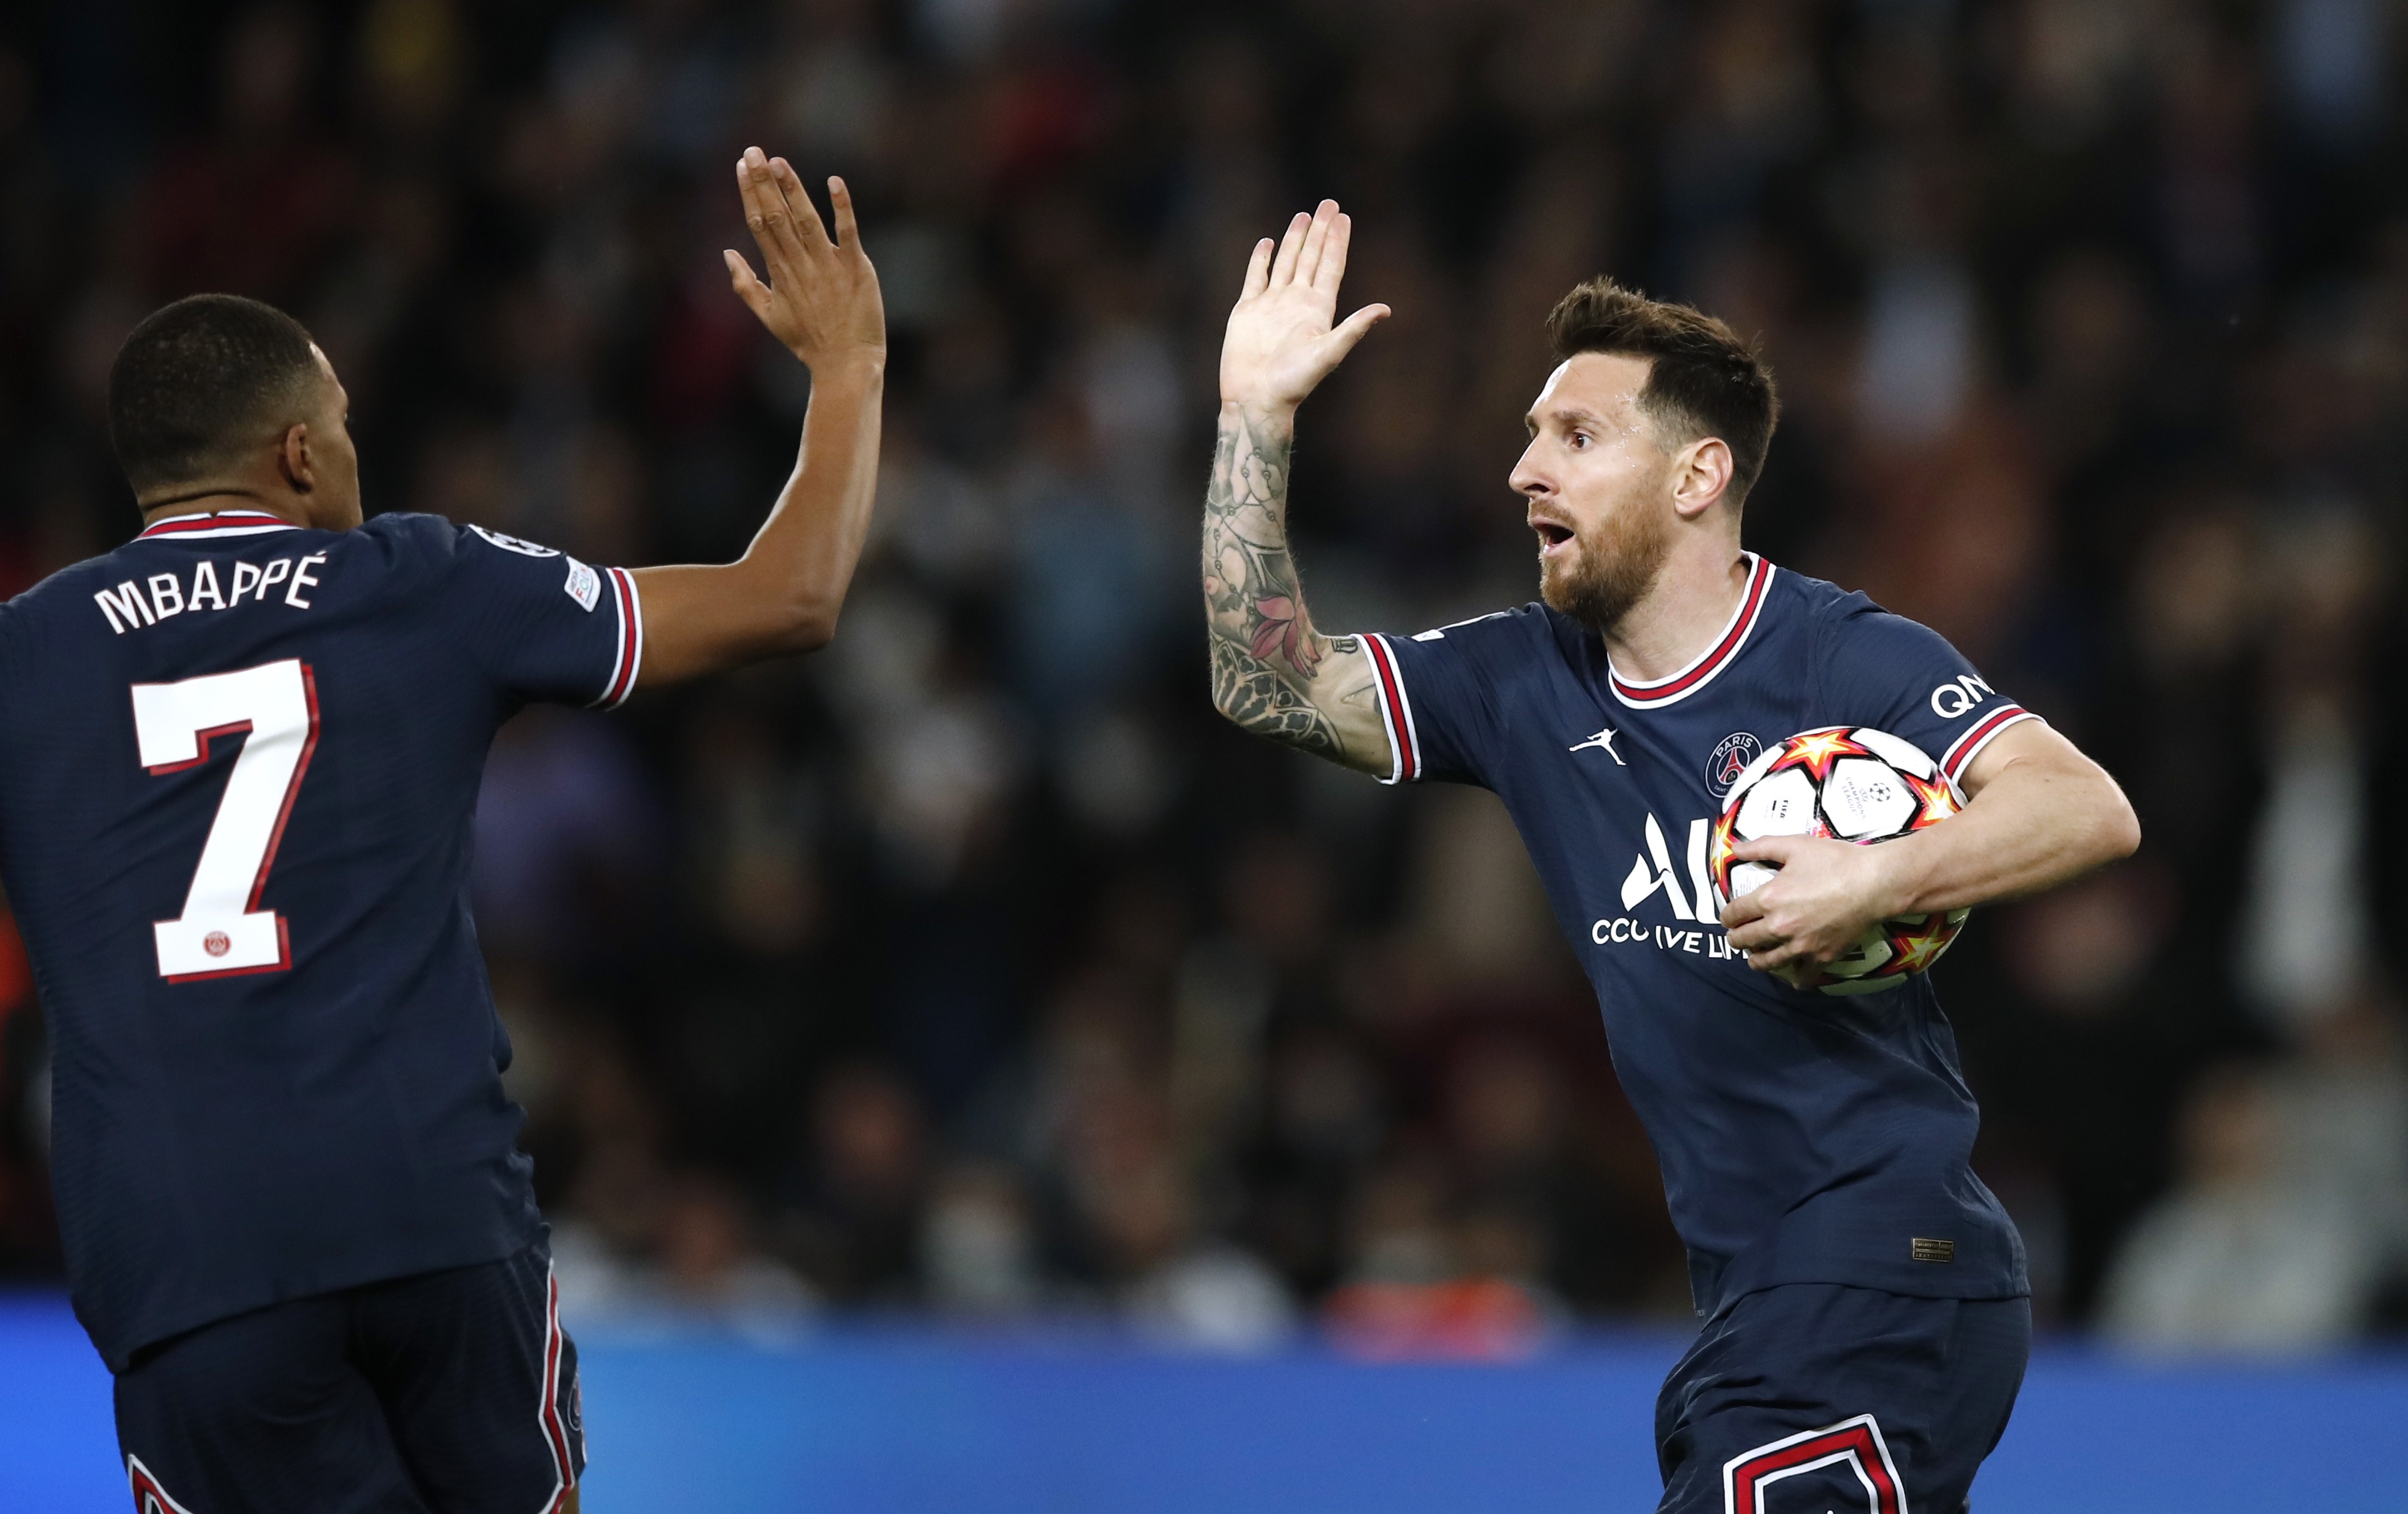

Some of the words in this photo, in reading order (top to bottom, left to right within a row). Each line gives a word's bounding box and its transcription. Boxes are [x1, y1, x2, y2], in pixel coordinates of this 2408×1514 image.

[94, 550, 327, 635] MBAPPÉ
[1715, 735, 1753, 757] PARIS
[131, 658, 320, 985] 7
[1780, 800, 1789, 819] FIFA
